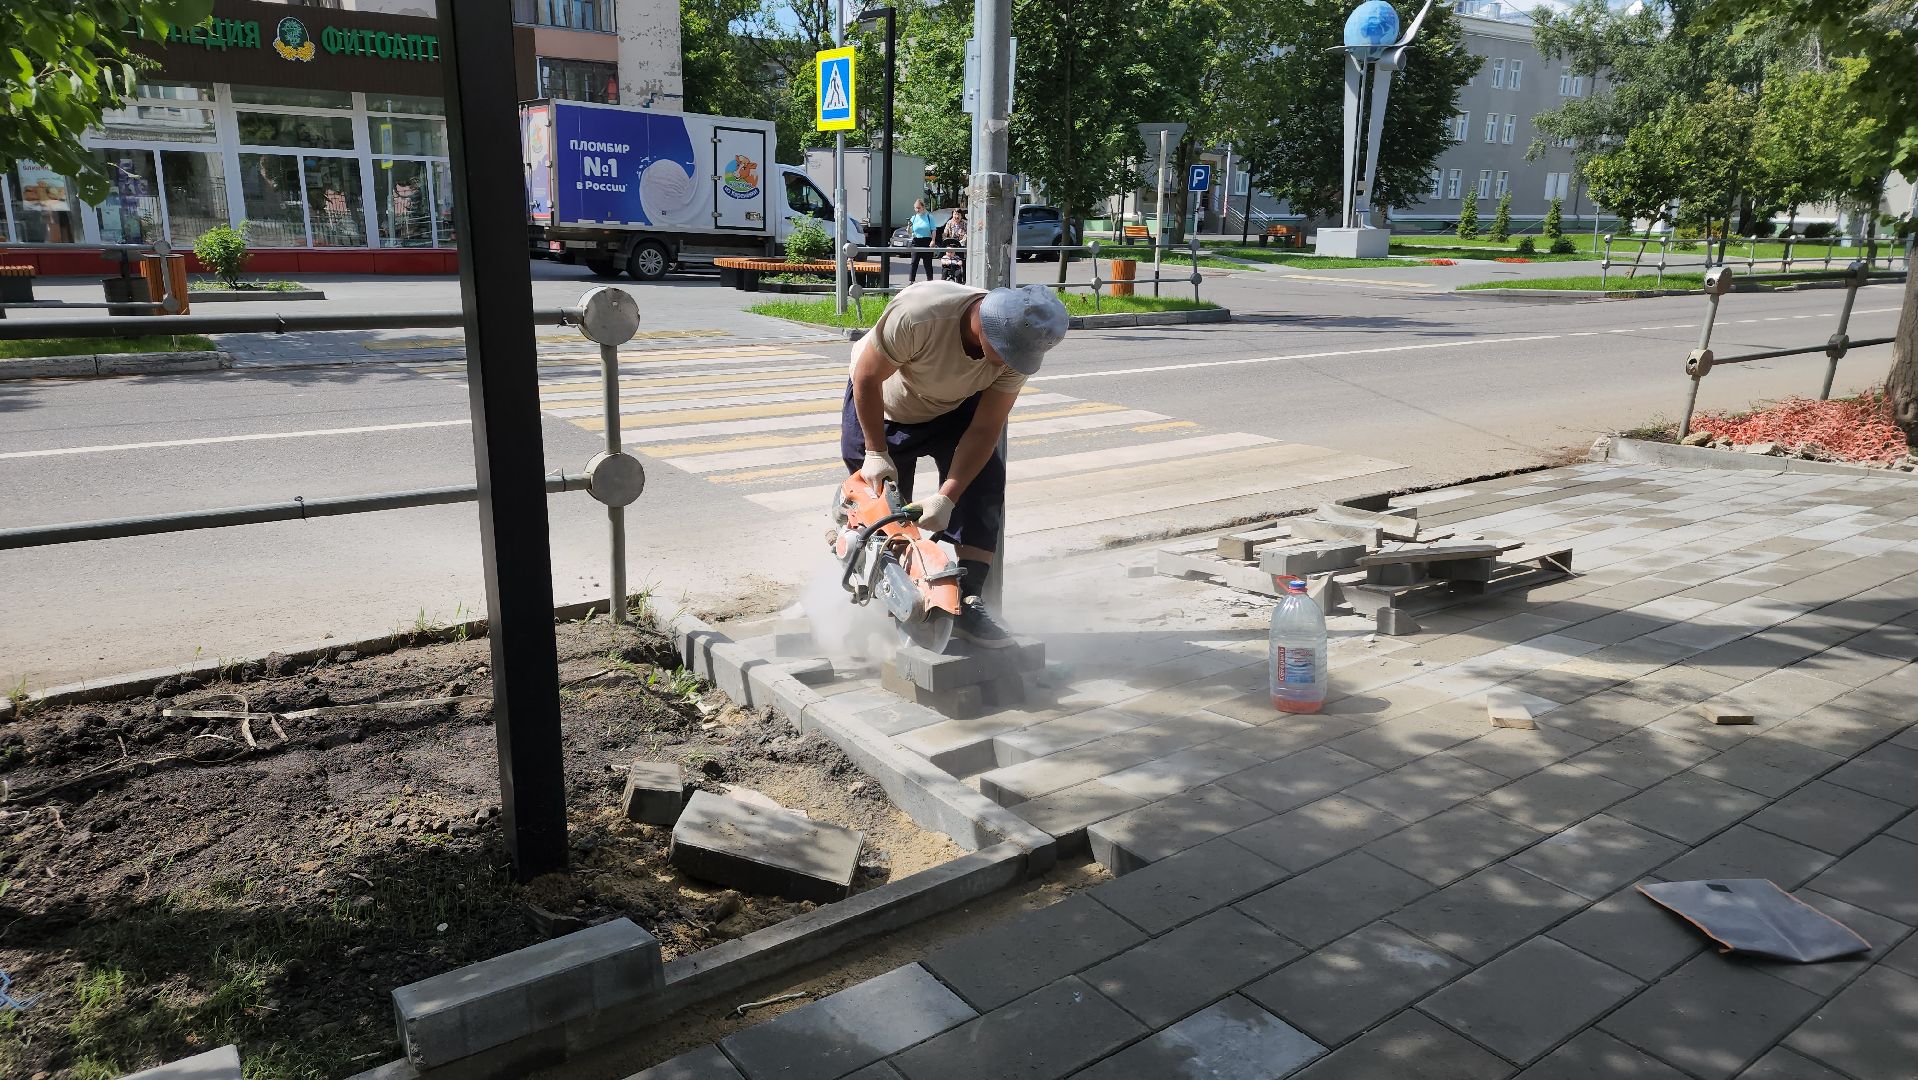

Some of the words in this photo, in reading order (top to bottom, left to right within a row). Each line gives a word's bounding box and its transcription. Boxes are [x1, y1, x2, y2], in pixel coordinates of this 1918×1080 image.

[137, 16, 261, 51] ПЕДИЯ
[321, 26, 441, 63] ФИТОАПТ
[569, 139, 630, 154] ПЛОМБИР
[583, 156, 618, 178] №1
[576, 181, 583, 190] в
[1192, 168, 1205, 188] P
